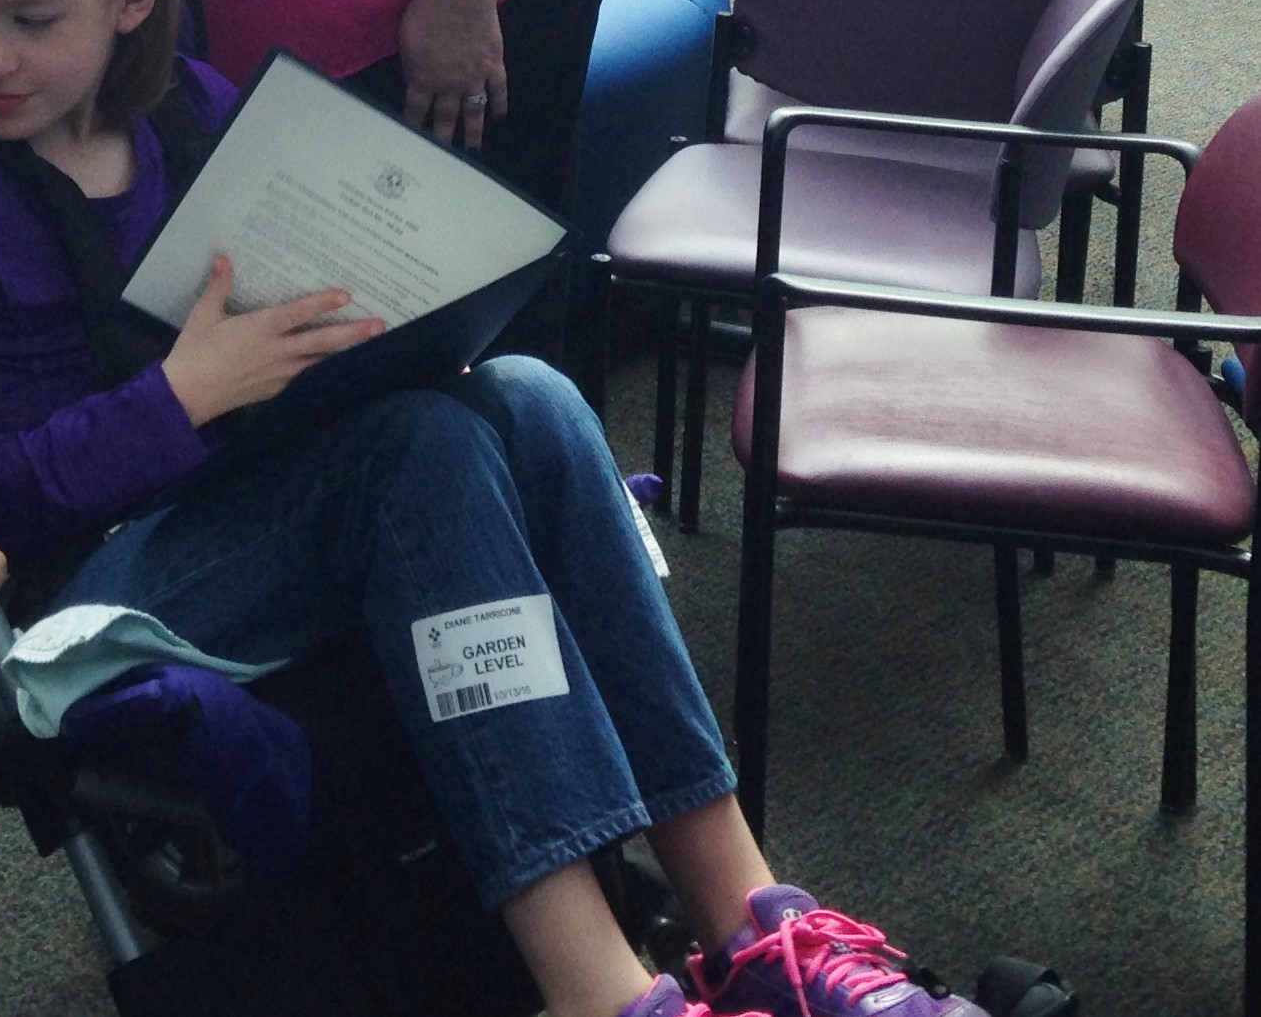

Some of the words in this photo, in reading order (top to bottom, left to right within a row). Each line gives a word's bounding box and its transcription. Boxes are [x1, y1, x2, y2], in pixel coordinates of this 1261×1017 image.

[444, 615, 472, 630] DIANE
[462, 634, 526, 660] GARDEN
[474, 654, 524, 675] LEVEL
